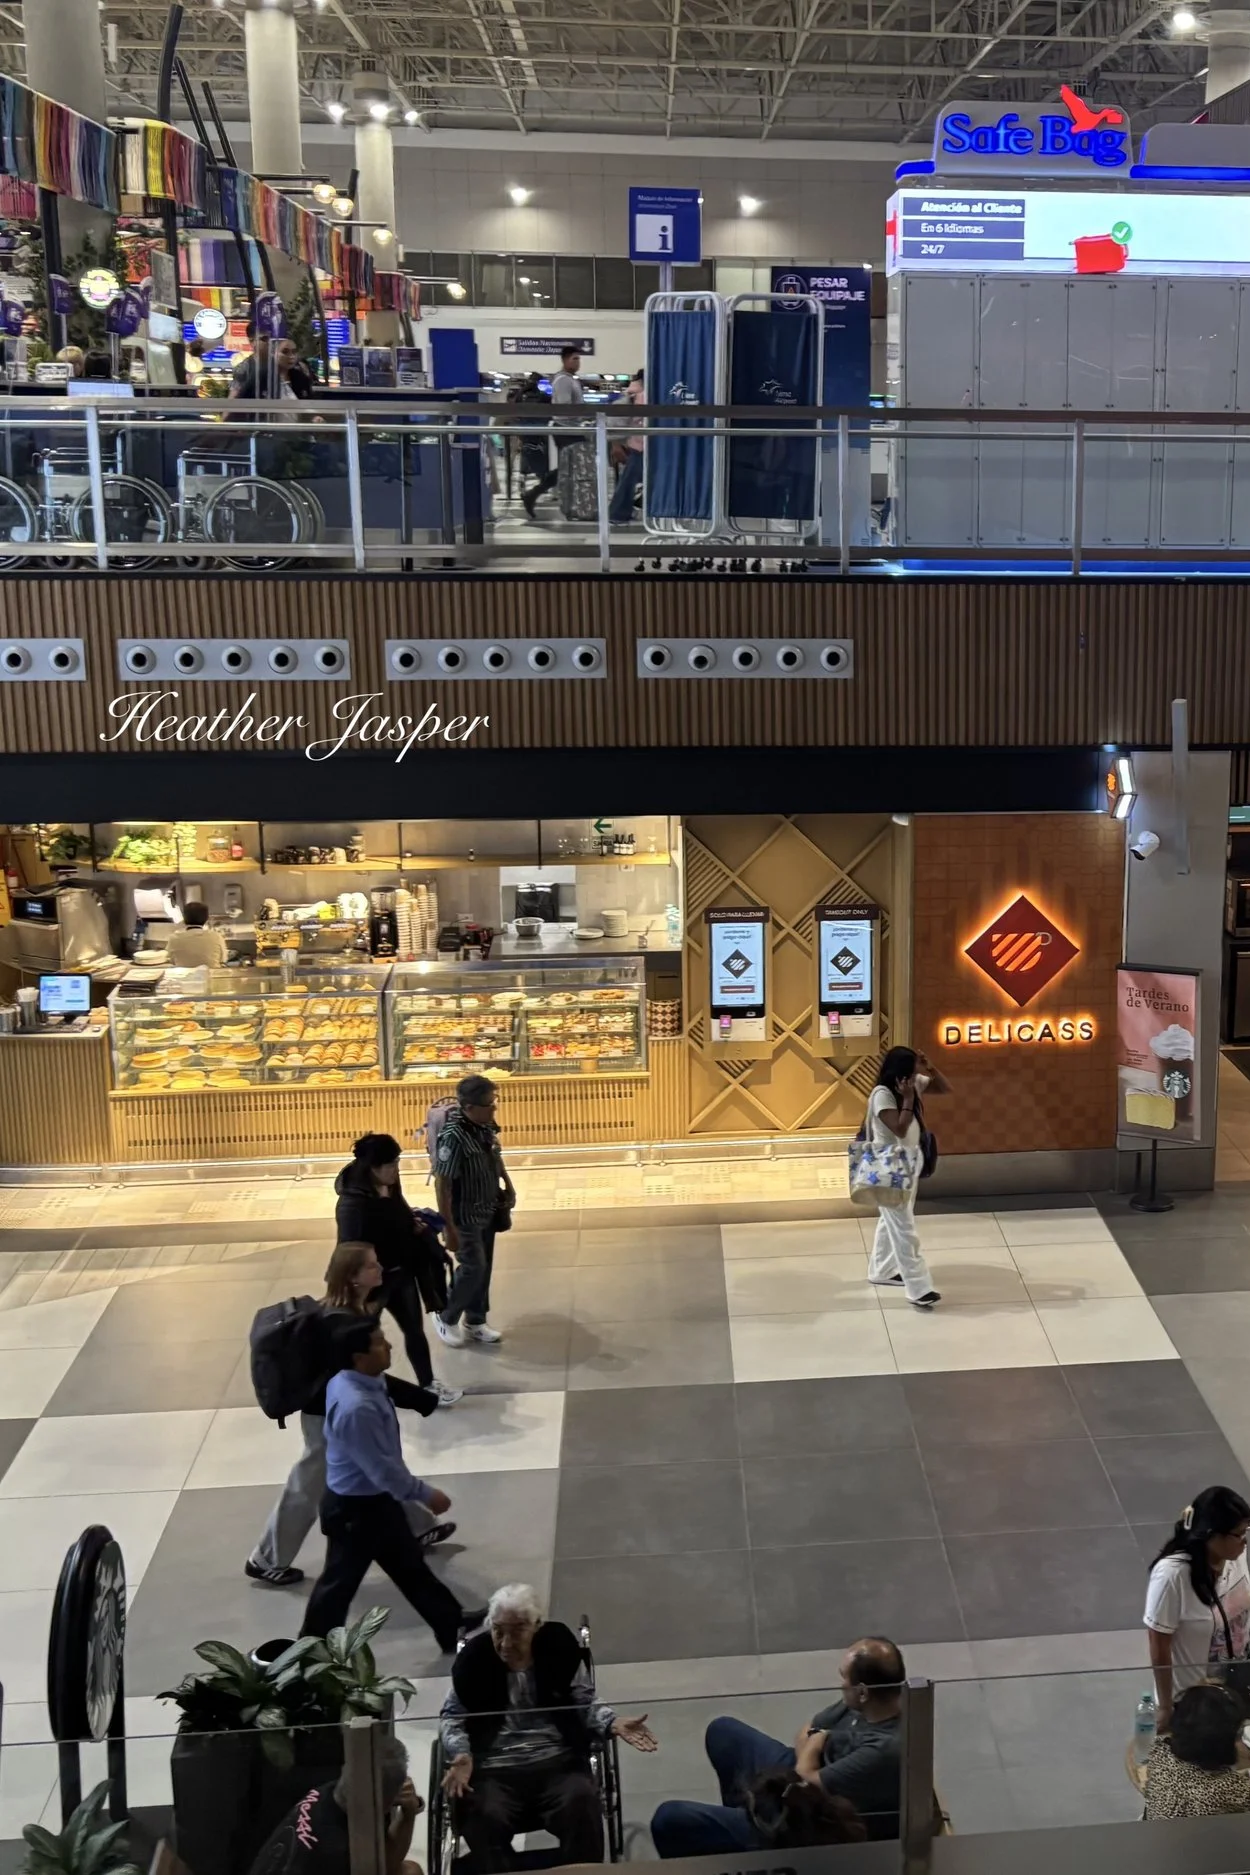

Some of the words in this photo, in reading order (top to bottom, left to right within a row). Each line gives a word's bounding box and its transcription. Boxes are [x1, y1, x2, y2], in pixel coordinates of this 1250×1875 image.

[942, 112, 1034, 155] Safe
[1039, 114, 1127, 167] Bag
[921, 201, 970, 212] Atención
[971, 202, 983, 213] al
[983, 202, 1022, 213] Cliente
[921, 223, 934, 233] En
[935, 224, 944, 233] 6
[944, 224, 985, 234] Idiomas
[921, 244, 945, 254] 24/7
[810, 278, 849, 288] PESAR
[810, 290, 866, 301] EQUIPAJE
[1126, 986, 1170, 1000] Tardes
[1126, 996, 1141, 1008] de
[1144, 998, 1189, 1013] Verano
[945, 1021, 1094, 1045] DELICASS
[296, 1788, 320, 1850] Messi
